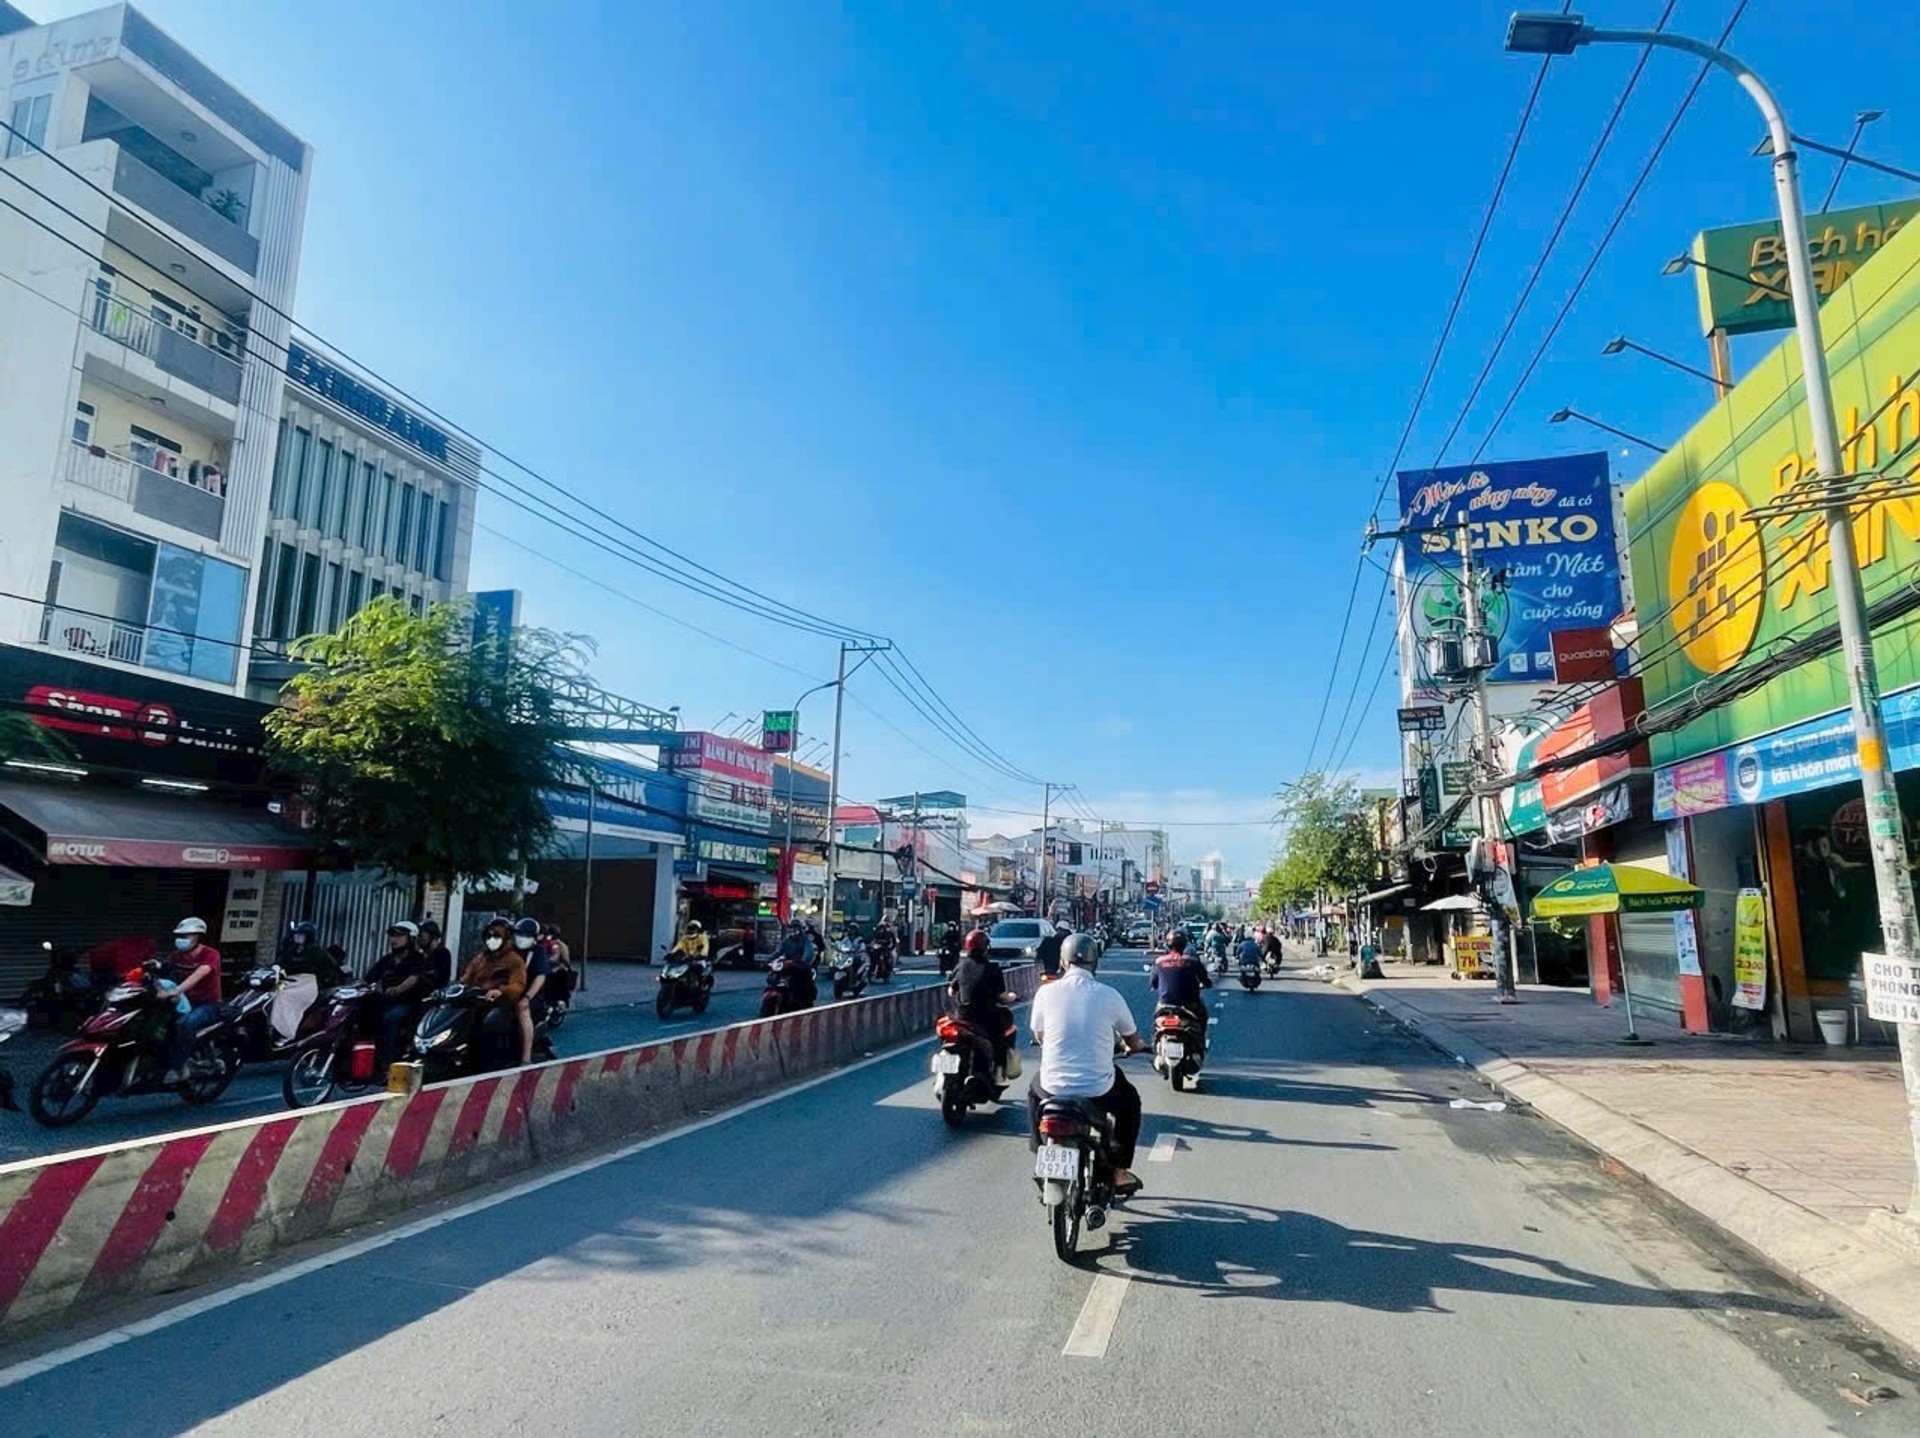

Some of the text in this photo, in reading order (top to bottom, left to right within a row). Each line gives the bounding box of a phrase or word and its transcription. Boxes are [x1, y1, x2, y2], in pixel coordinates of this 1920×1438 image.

[1751, 226, 1847, 267] Bch
[1558, 496, 1576, 507] đã
[1578, 494, 1593, 507] có
[1421, 514, 1598, 554] SENKO
[1546, 552, 1605, 577] Mát
[1542, 583, 1573, 598] cho
[1522, 600, 1603, 622] cuộc sống
[1558, 649, 1610, 662] guardian
[51, 842, 105, 858] MOTUL
[218, 850, 227, 862] 2
[1873, 962, 1903, 978] CHO
